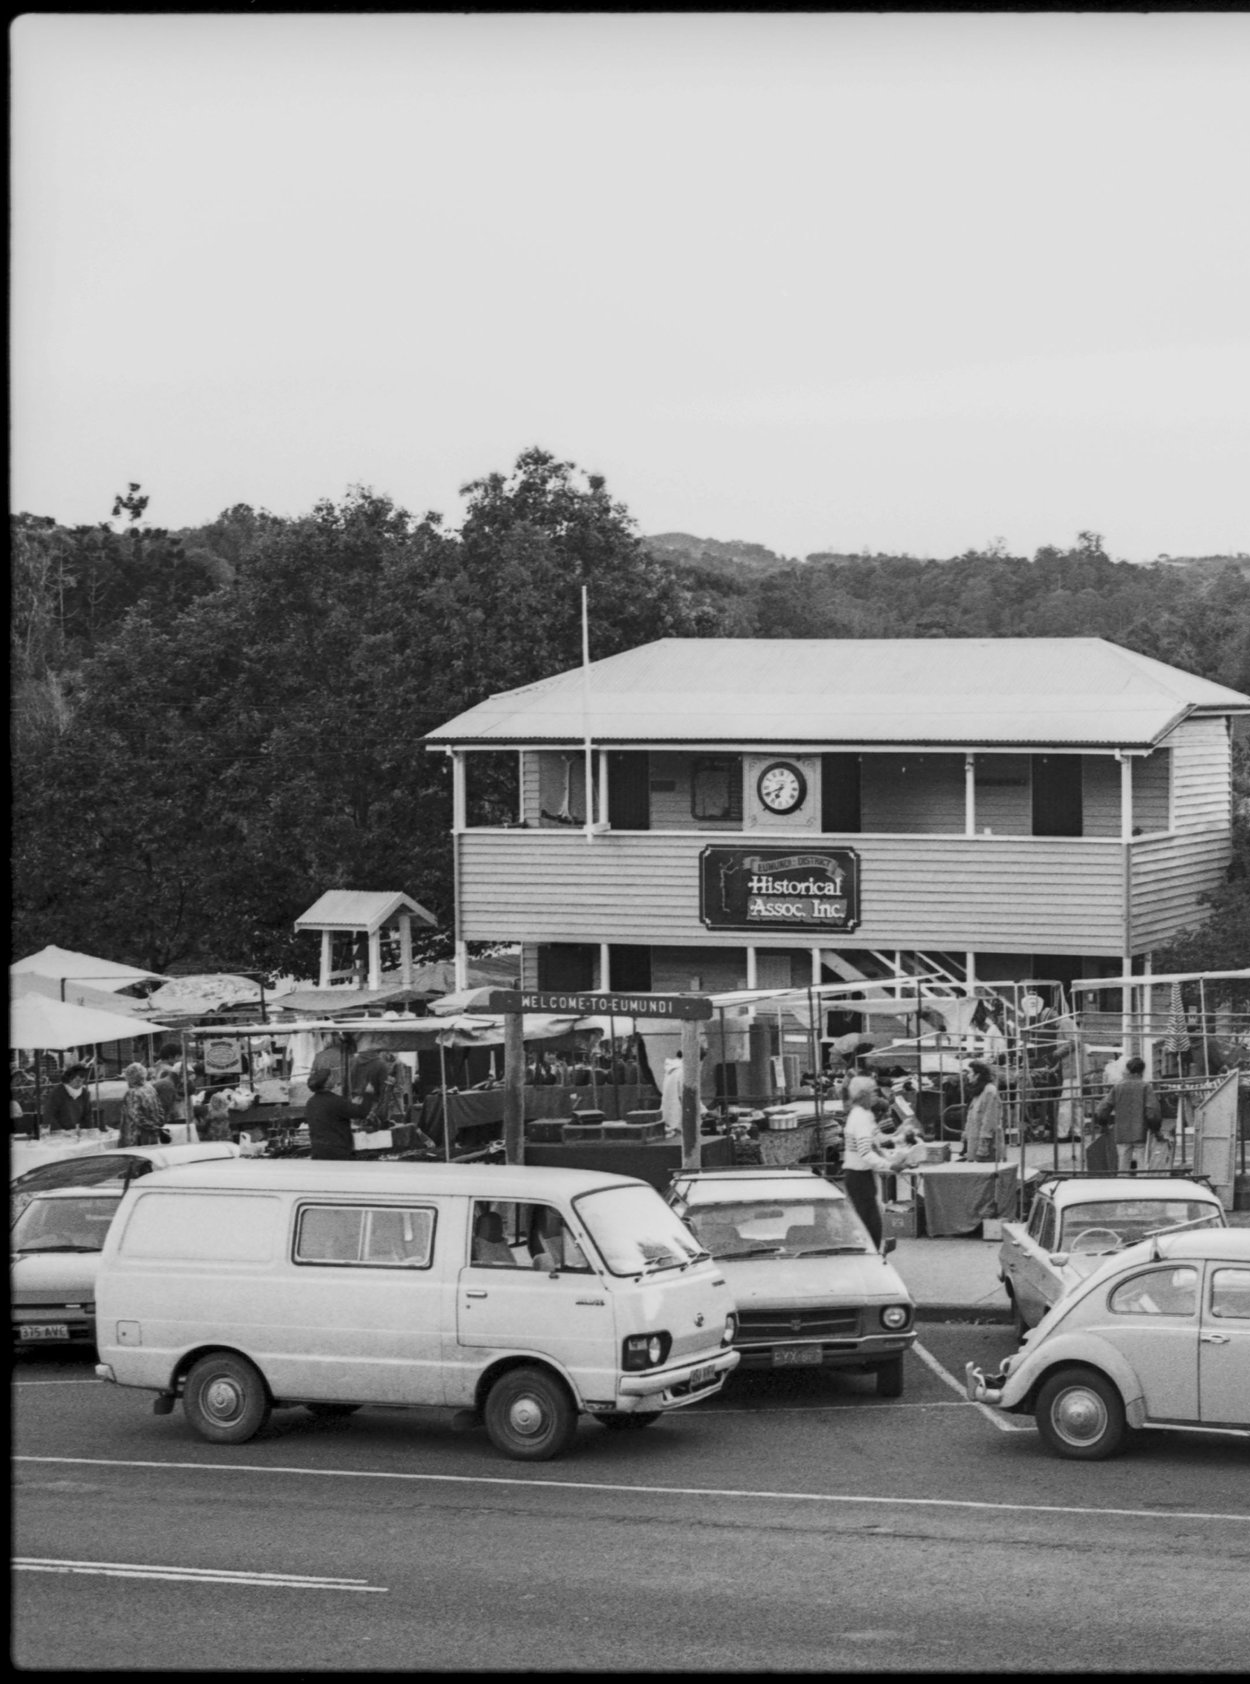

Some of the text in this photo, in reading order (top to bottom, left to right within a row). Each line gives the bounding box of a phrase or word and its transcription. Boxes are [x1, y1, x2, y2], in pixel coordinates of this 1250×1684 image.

[748, 875, 843, 895] Historical
[750, 898, 846, 918] Assoc. Inc.
